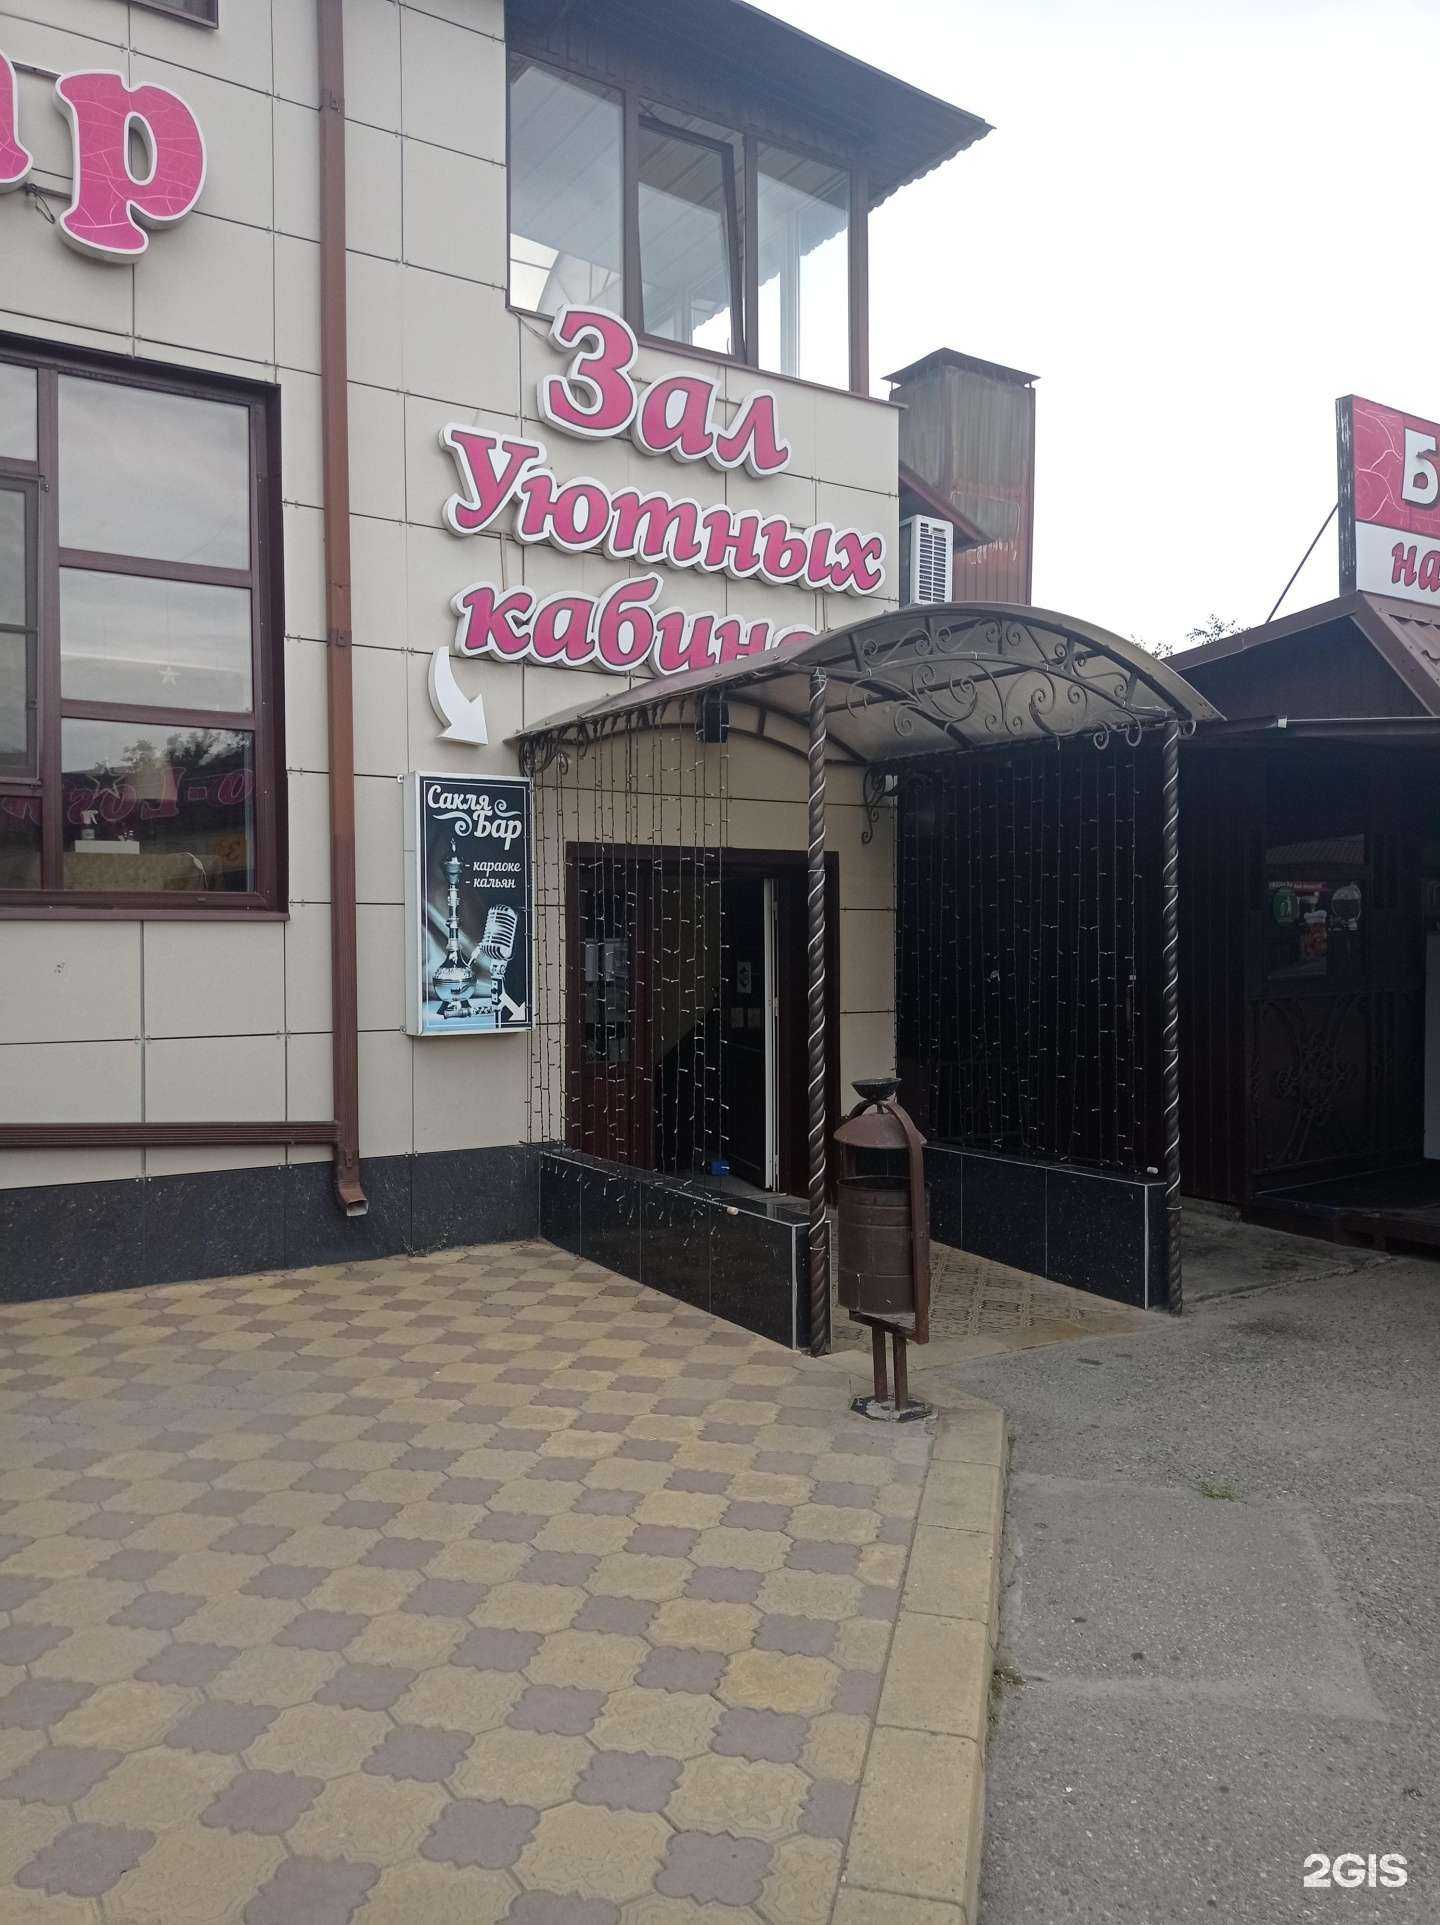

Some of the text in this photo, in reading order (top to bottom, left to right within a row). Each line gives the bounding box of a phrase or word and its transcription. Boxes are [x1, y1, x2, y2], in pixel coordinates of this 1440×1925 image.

[540, 305, 791, 476] Зал
[452, 574, 821, 674] кабин
[427, 785, 493, 811] Сакля
[472, 809, 522, 850] Бар
[473, 861, 522, 877] караоке
[473, 878, 516, 889] кальян
